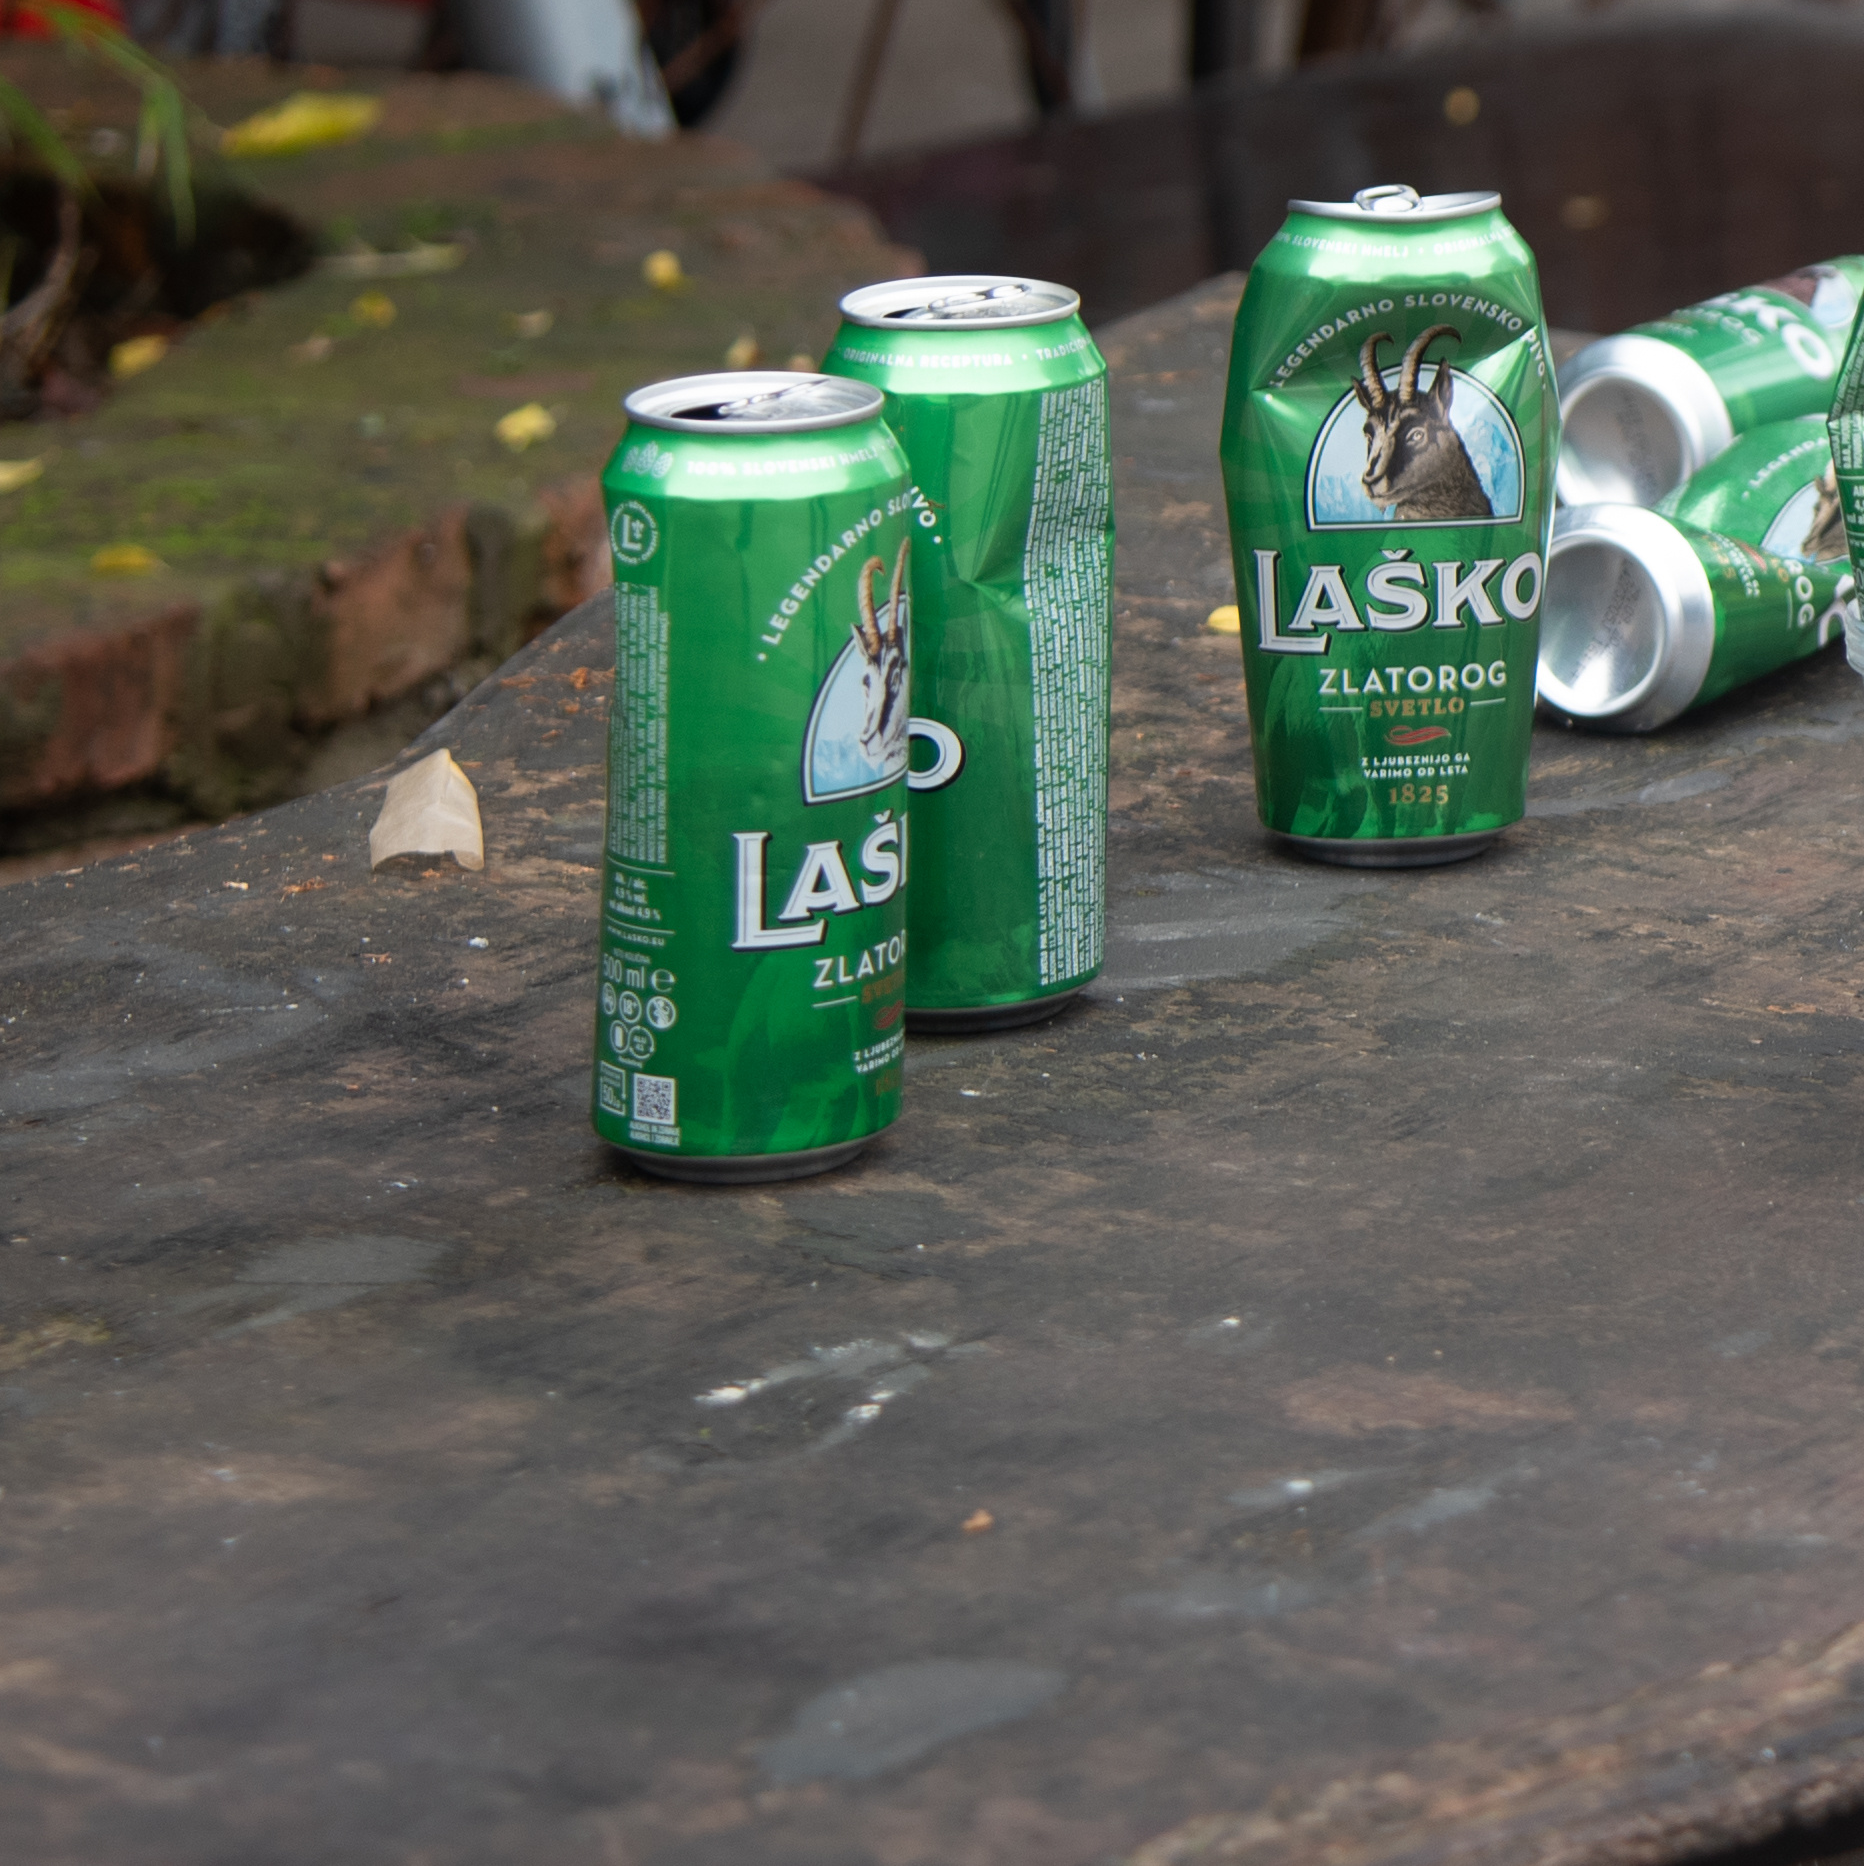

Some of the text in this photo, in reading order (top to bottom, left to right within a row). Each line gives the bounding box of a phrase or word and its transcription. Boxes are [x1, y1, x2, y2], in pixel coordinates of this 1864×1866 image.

[1269, 298, 1395, 389] LEGENDARNO
[1404, 292, 1524, 332] SLOVENSKO
[761, 508, 883, 646] LEGENDARNO
[1253, 548, 1544, 656] LAŠKO
[1318, 659, 1507, 695] ZLATOROG
[1369, 697, 1466, 718] SVETLO
[1361, 752, 1471, 767] Z LJUBEZNIJO GA
[1363, 764, 1469, 779] VARIMO OD LETA
[1389, 783, 1449, 805] 1825
[731, 808, 908, 953] LAŠ
[812, 929, 906, 988] ZLATO
[626, 965, 645, 990] ml
